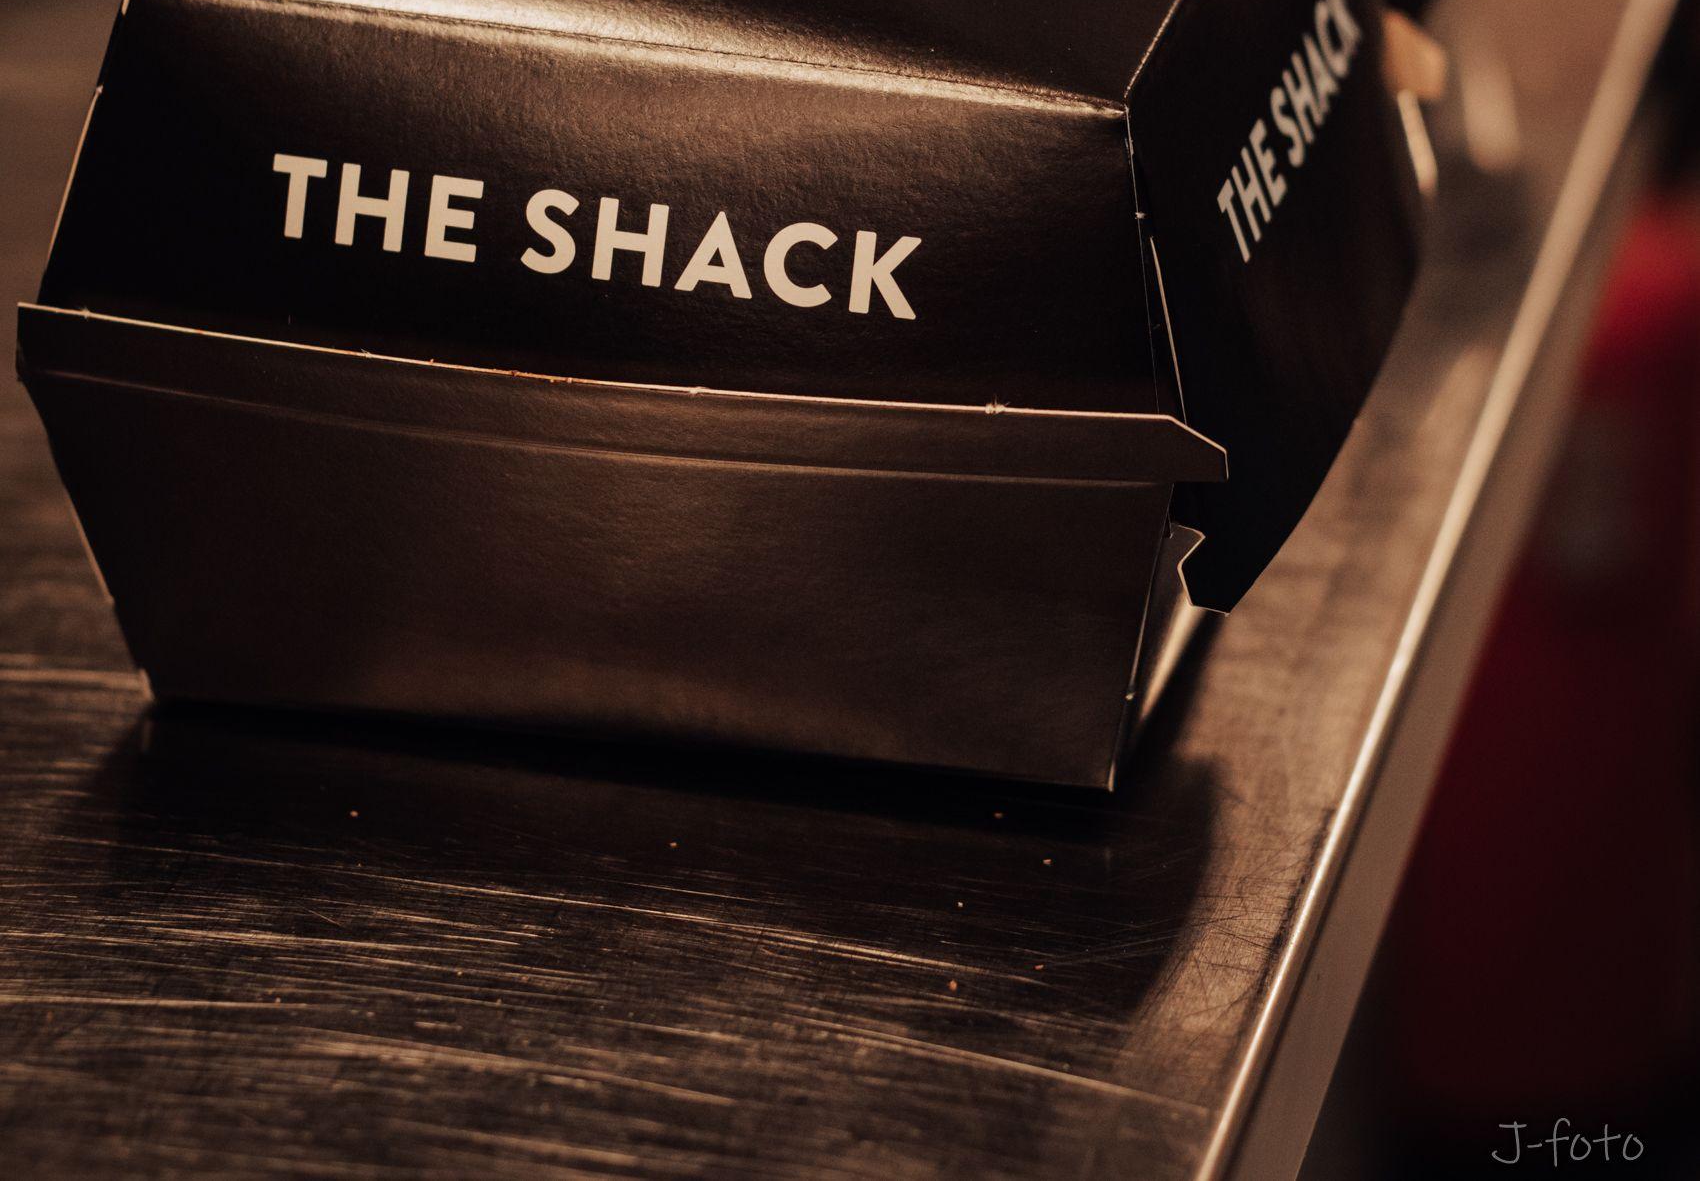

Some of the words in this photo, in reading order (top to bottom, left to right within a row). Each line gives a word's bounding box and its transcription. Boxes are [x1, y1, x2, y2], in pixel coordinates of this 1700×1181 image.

[272, 153, 485, 263] THE
[519, 188, 923, 320] SHACK
[1217, 118, 1287, 263] THE
